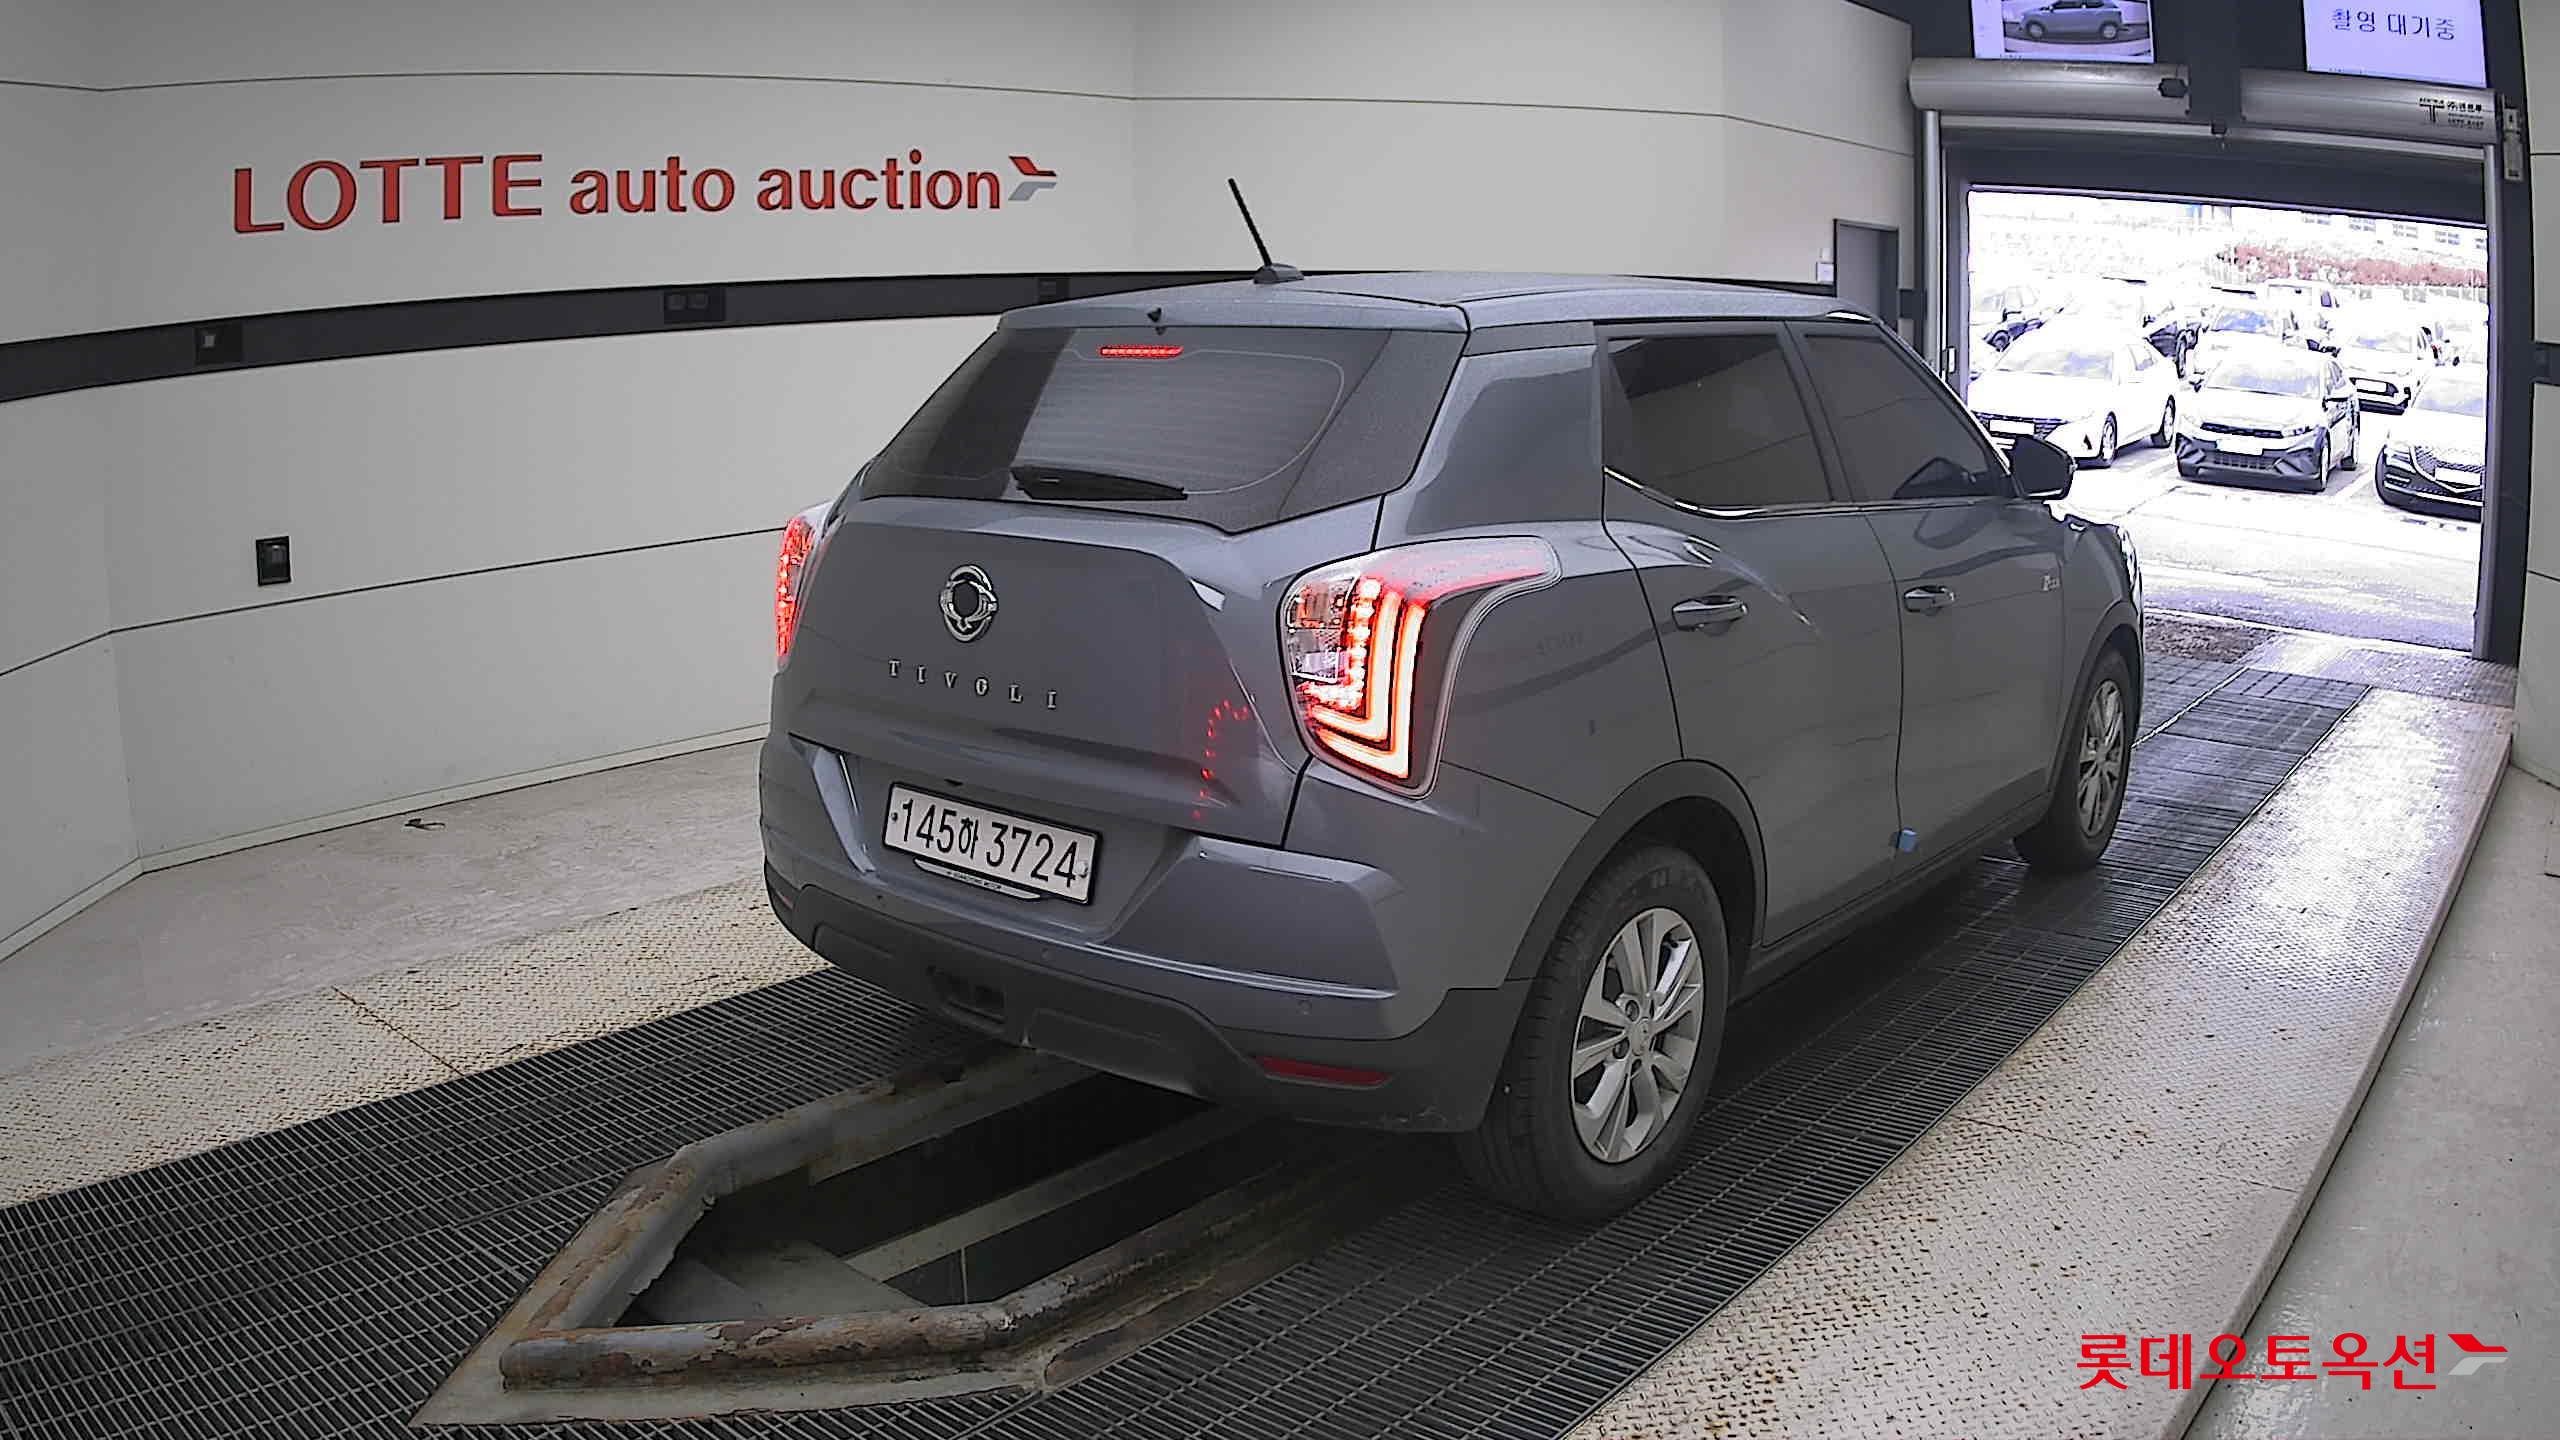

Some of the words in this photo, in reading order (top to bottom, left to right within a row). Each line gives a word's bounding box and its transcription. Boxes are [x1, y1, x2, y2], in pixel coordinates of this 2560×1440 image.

[234, 154, 543, 234] LOTTE
[569, 156, 735, 215] auto
[756, 148, 1001, 211] auction
[888, 658, 1057, 710] TIVOLI
